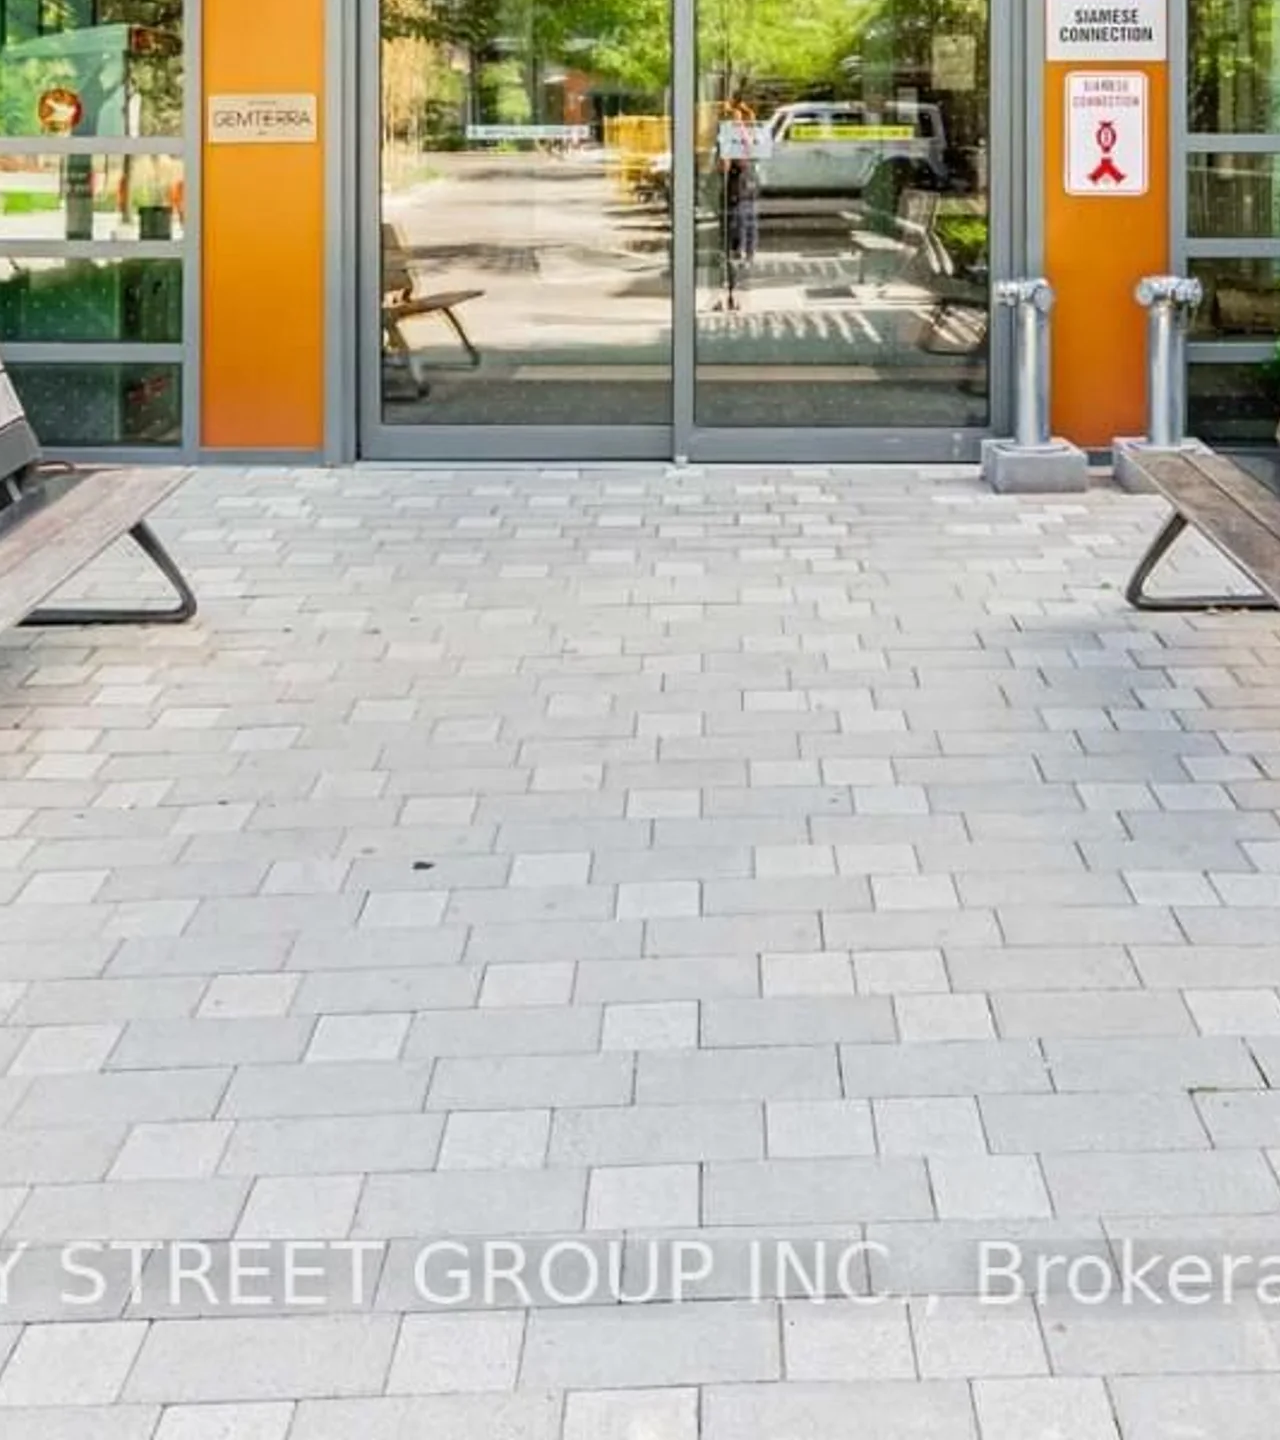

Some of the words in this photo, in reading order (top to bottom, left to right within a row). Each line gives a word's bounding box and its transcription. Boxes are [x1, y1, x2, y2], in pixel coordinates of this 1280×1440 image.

[1074, 8, 1140, 25] SIAMESE
[1058, 26, 1154, 43] CONNECTION
[214, 110, 312, 128] GEMTERRA
